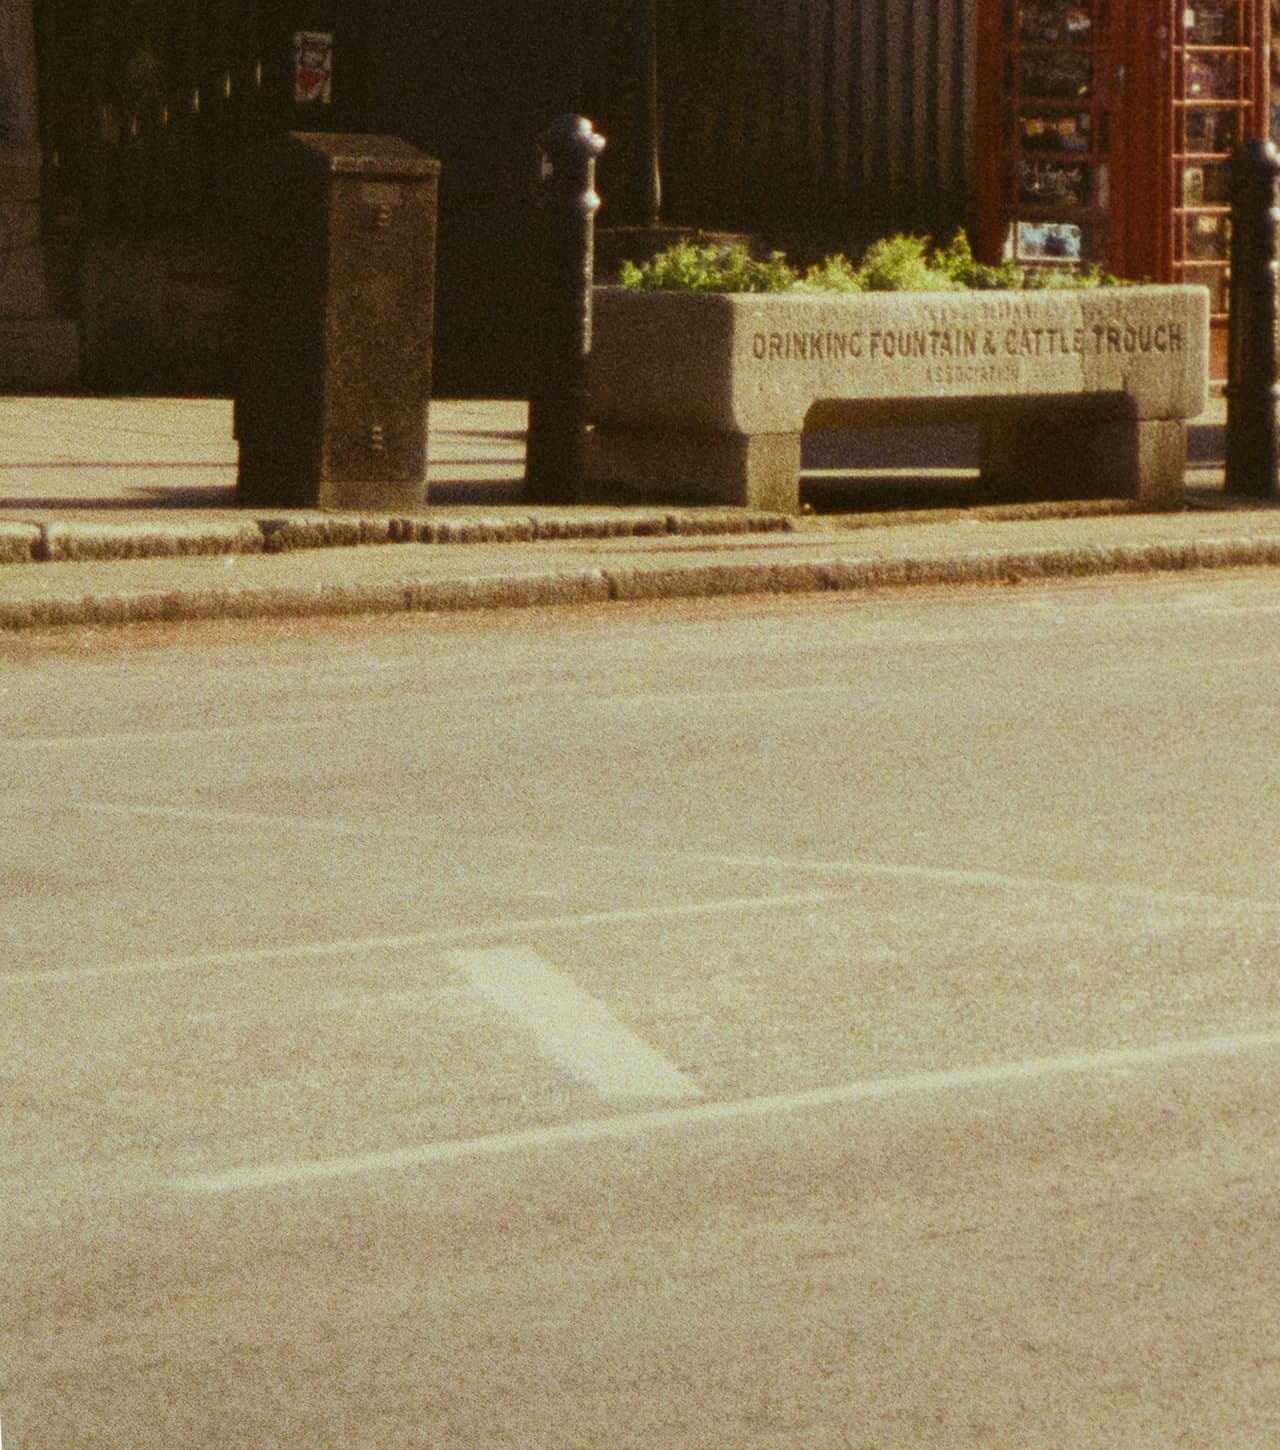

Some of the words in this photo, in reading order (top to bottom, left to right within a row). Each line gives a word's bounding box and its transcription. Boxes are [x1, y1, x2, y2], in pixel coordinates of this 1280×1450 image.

[752, 330, 861, 361] DRINKING
[869, 329, 976, 359] FOUNTAIN
[982, 331, 997, 356] &
[1005, 327, 1084, 356] CATTLE
[1092, 324, 1184, 354] TROUGH
